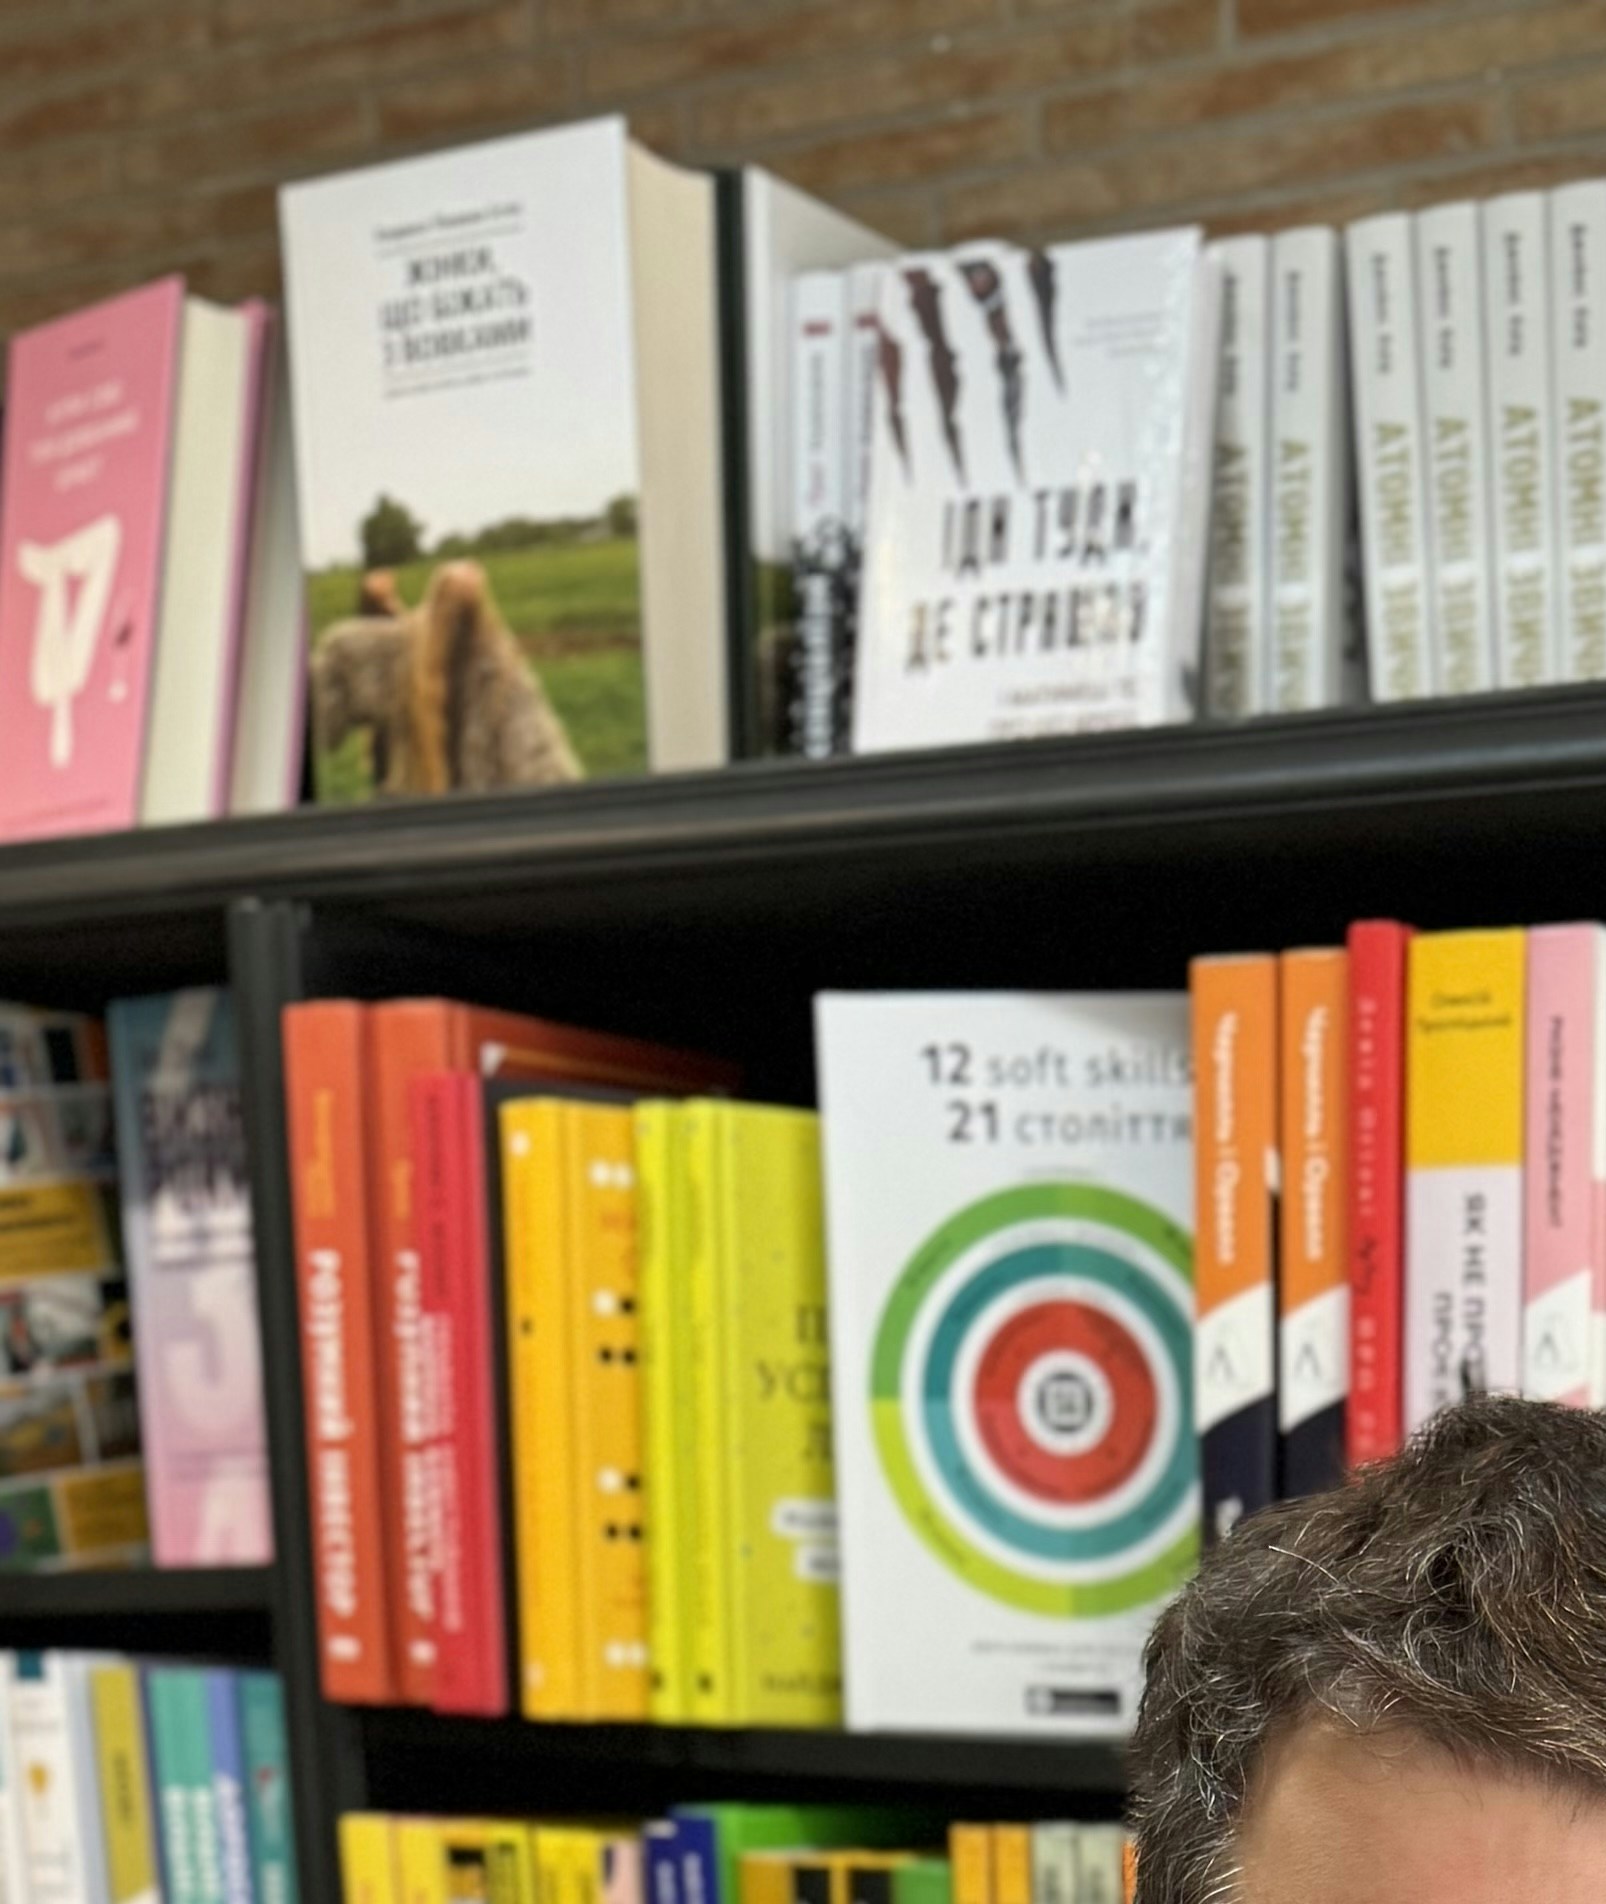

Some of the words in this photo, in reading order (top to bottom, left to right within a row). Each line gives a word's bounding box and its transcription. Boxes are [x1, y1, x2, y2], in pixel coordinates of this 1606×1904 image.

[920, 1043, 971, 1085] 12
[987, 1045, 1069, 1086] soft
[1086, 1045, 1195, 1086] skills
[947, 1100, 999, 1143] 21
[1014, 1103, 1191, 1144] століття
[1462, 1192, 1485, 1235] ЯК
[1462, 1246, 1485, 1286] НЕ
